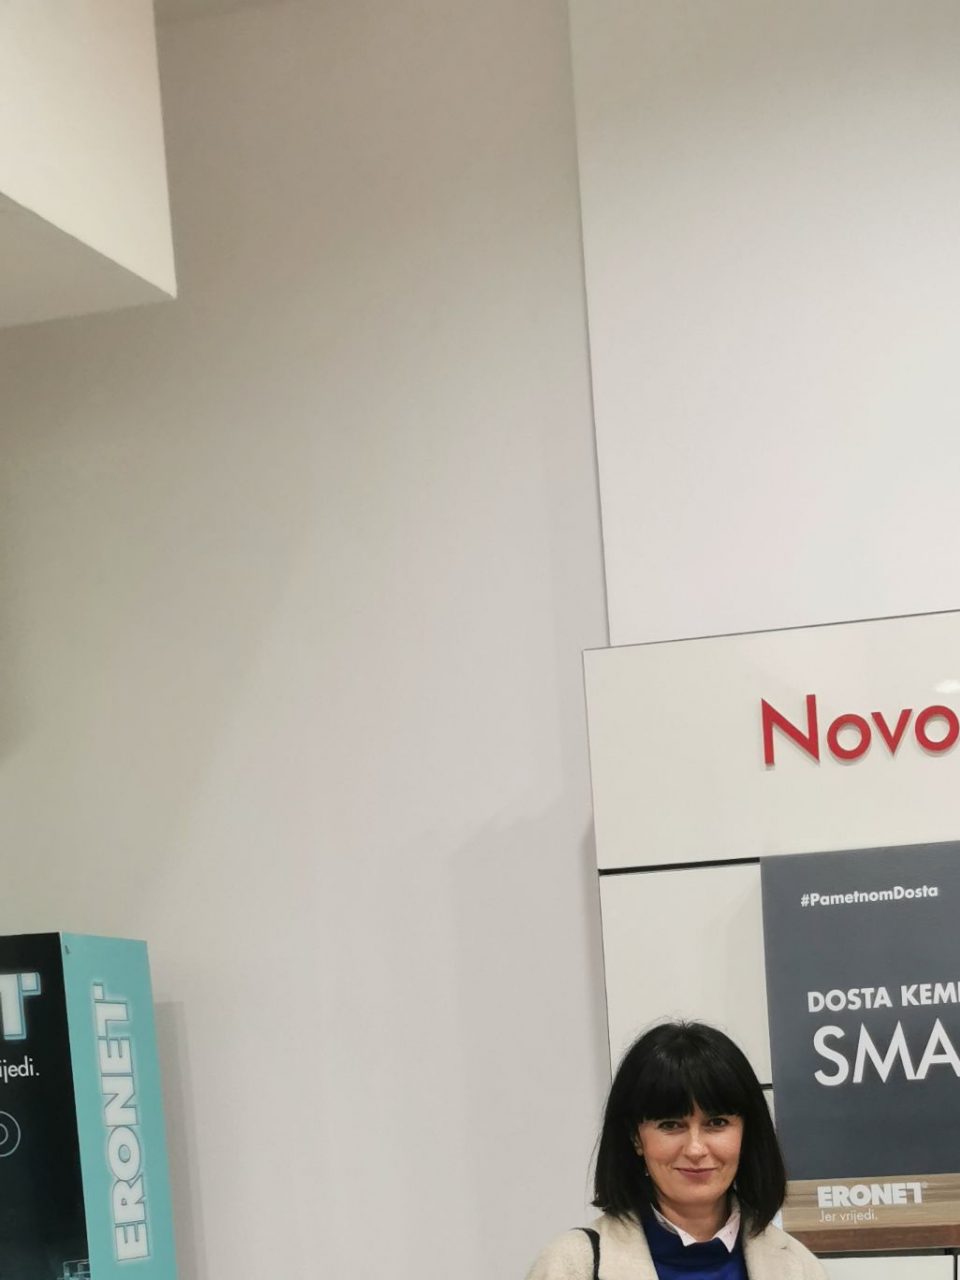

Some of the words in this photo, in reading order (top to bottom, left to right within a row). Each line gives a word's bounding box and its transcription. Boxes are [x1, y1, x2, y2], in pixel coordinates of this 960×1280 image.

[761, 695, 960, 766] Novo
[800, 885, 938, 907] #PametnomDosta
[807, 987, 893, 1013] DOSTA
[93, 982, 150, 1261] ERONET
[817, 1182, 923, 1208] ERONET
[819, 1210, 837, 1223] Jer
